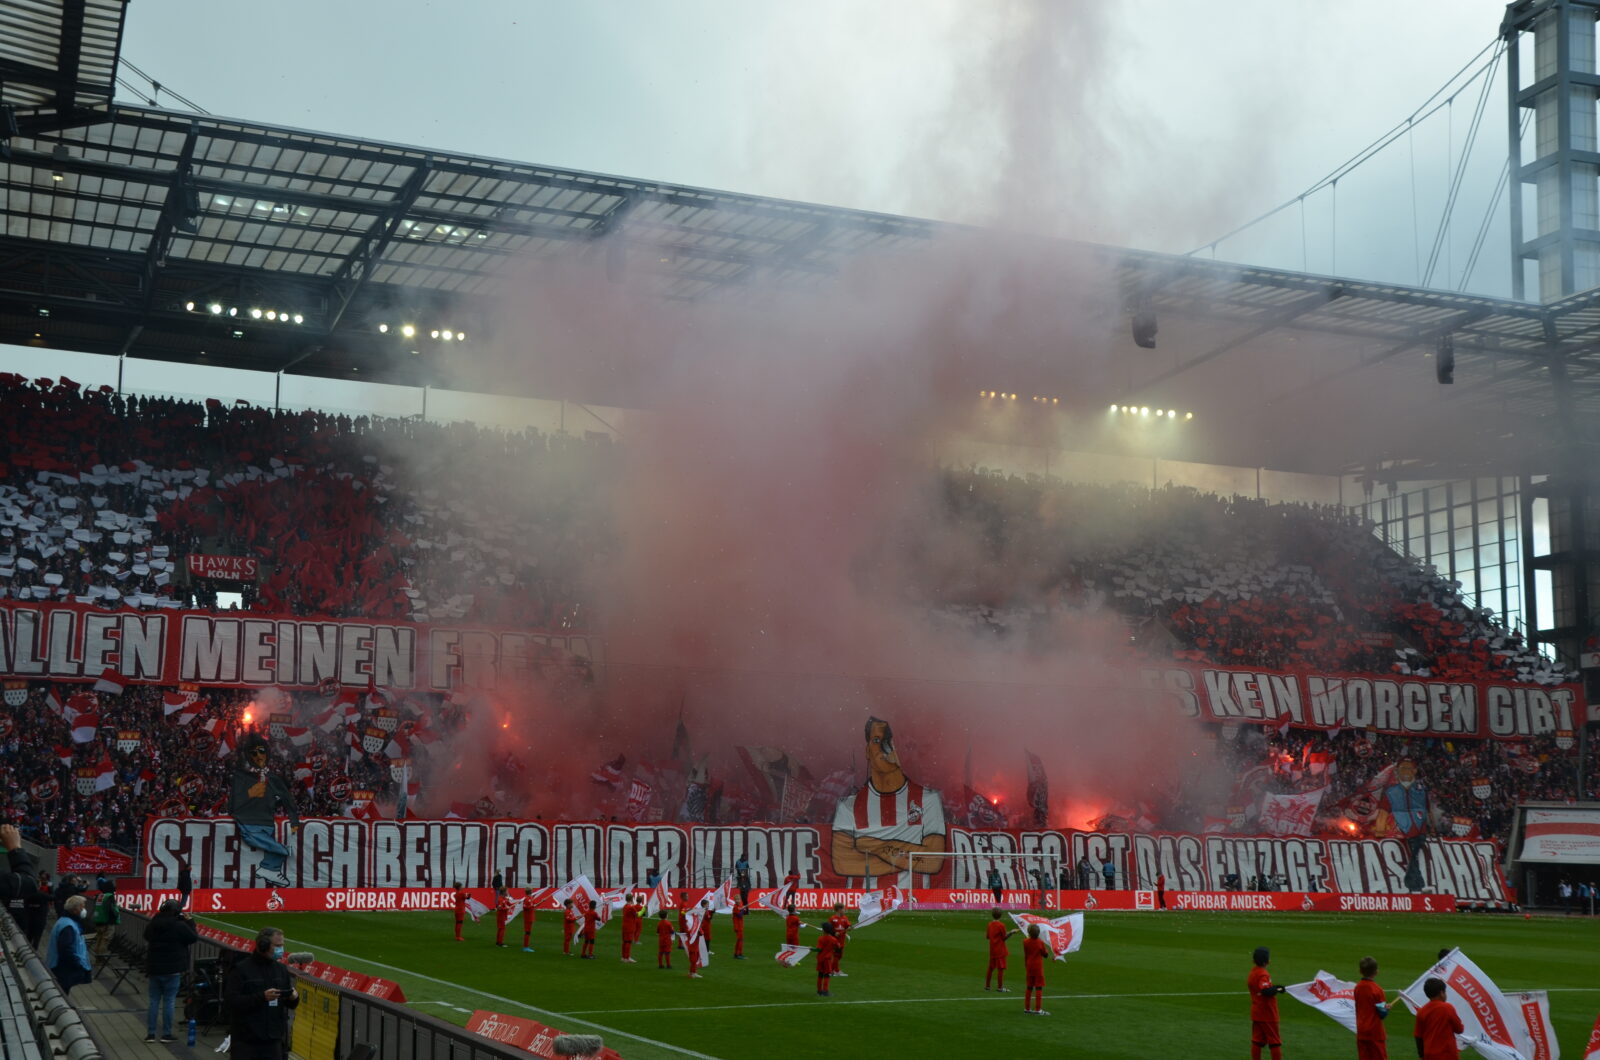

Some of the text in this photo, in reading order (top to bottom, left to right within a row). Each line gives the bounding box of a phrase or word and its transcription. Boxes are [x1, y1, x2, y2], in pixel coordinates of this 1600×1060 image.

[190, 556, 256, 575] HAWKS
[207, 568, 240, 580] KÖLN
[181, 615, 416, 689] MEINEN
[1202, 669, 1305, 724] KEIN
[1307, 676, 1479, 735] MORGEN
[1488, 685, 1576, 735] GIBT
[275, 819, 369, 889] ICH
[372, 821, 489, 889] BEIM
[492, 822, 550, 889] FC
[552, 823, 604, 889] IN
[606, 824, 688, 889] DER
[691, 826, 822, 889] KURVE
[950, 828, 1020, 890] DER
[1019, 831, 1071, 891] FC
[1072, 833, 1130, 891] IST
[1133, 834, 1205, 891] DAS
[1206, 837, 1331, 892] EINZIGE
[1328, 838, 1410, 894] WAS
[325, 889, 396, 908] SPÜRBAR
[821, 892, 863, 907] ANDER
[1177, 892, 1276, 909] SPÜRBAR ANDERS.
[1340, 893, 1388, 910] SPÜRBAR
[1391, 896, 1412, 911] AND
[475, 1018, 520, 1042] DERTOUR
